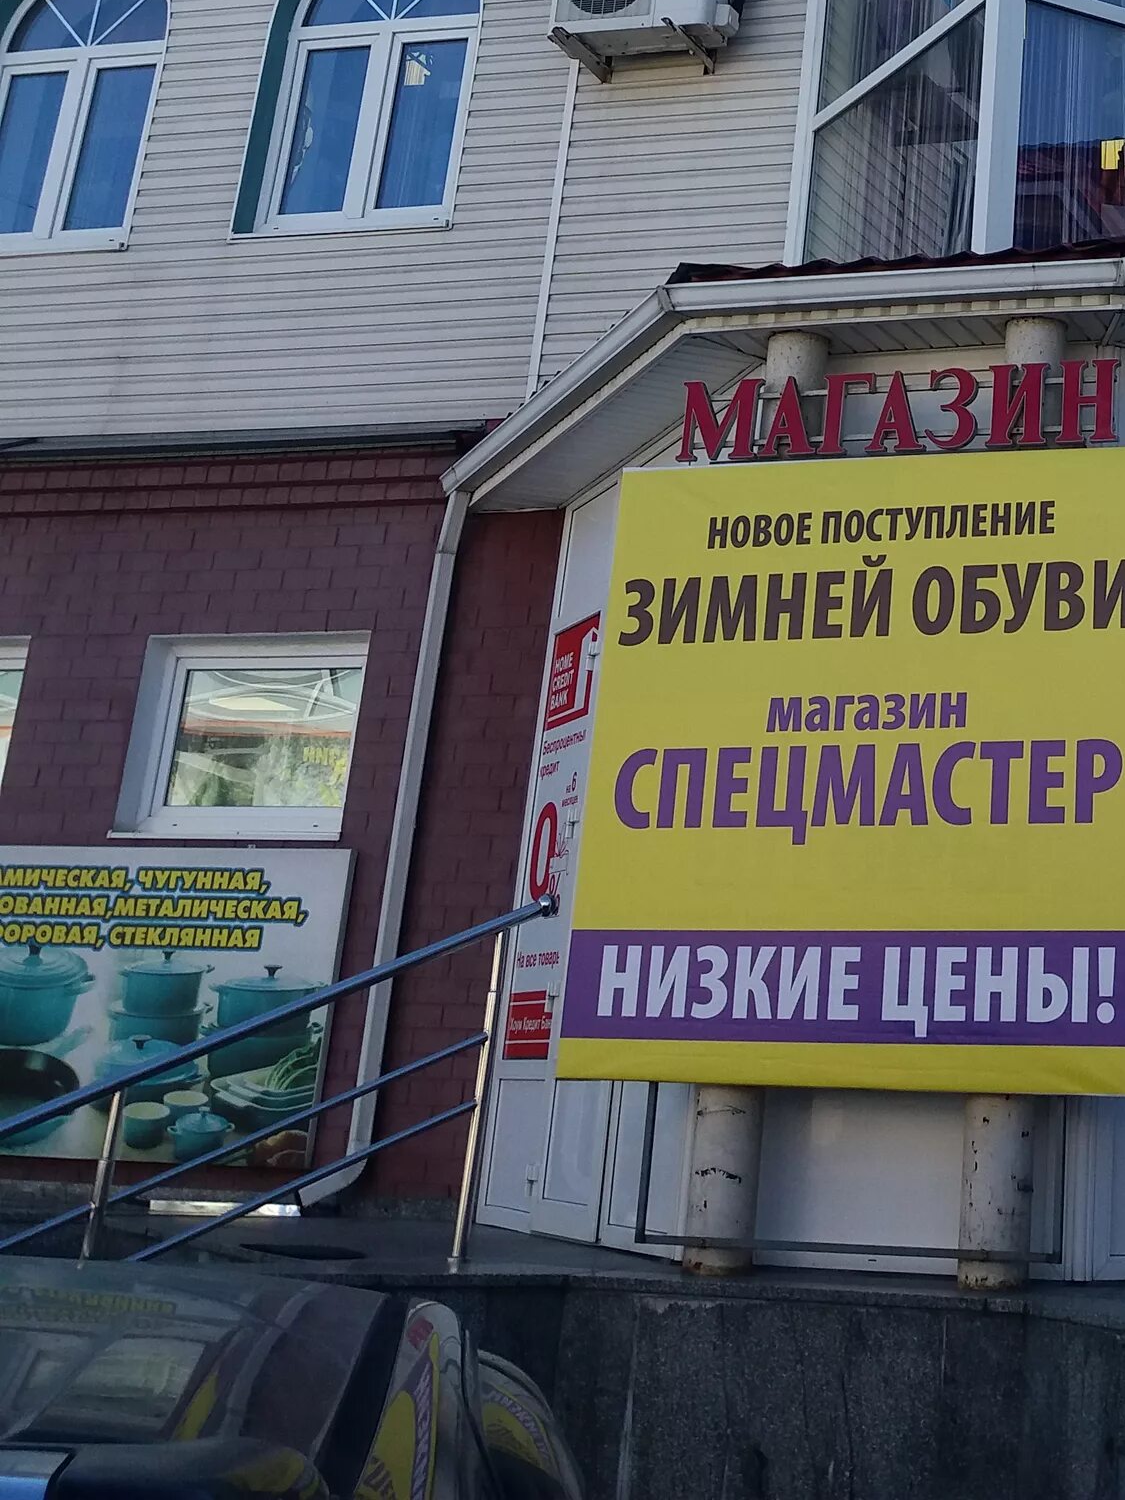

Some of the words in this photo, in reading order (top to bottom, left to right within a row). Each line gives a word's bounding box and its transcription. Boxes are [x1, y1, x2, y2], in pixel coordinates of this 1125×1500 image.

[676, 359, 1121, 462] МАГАЗИН
[707, 511, 812, 550] НОВОЕ
[820, 500, 1056, 544] ПОСТУПЛЕНИЕ
[618, 555, 893, 646] ЗИМНЕЙ
[766, 692, 968, 733] магазин
[614, 738, 1124, 845] СПЕЦМАСТЕР
[138, 869, 268, 893] ЧУГУННАЯ,
[110, 925, 260, 948] СТЕКЛЯННАЯ
[596, 945, 861, 1020] НИЗКИЕ
[881, 946, 1118, 1038] ЦЕНЫ!
